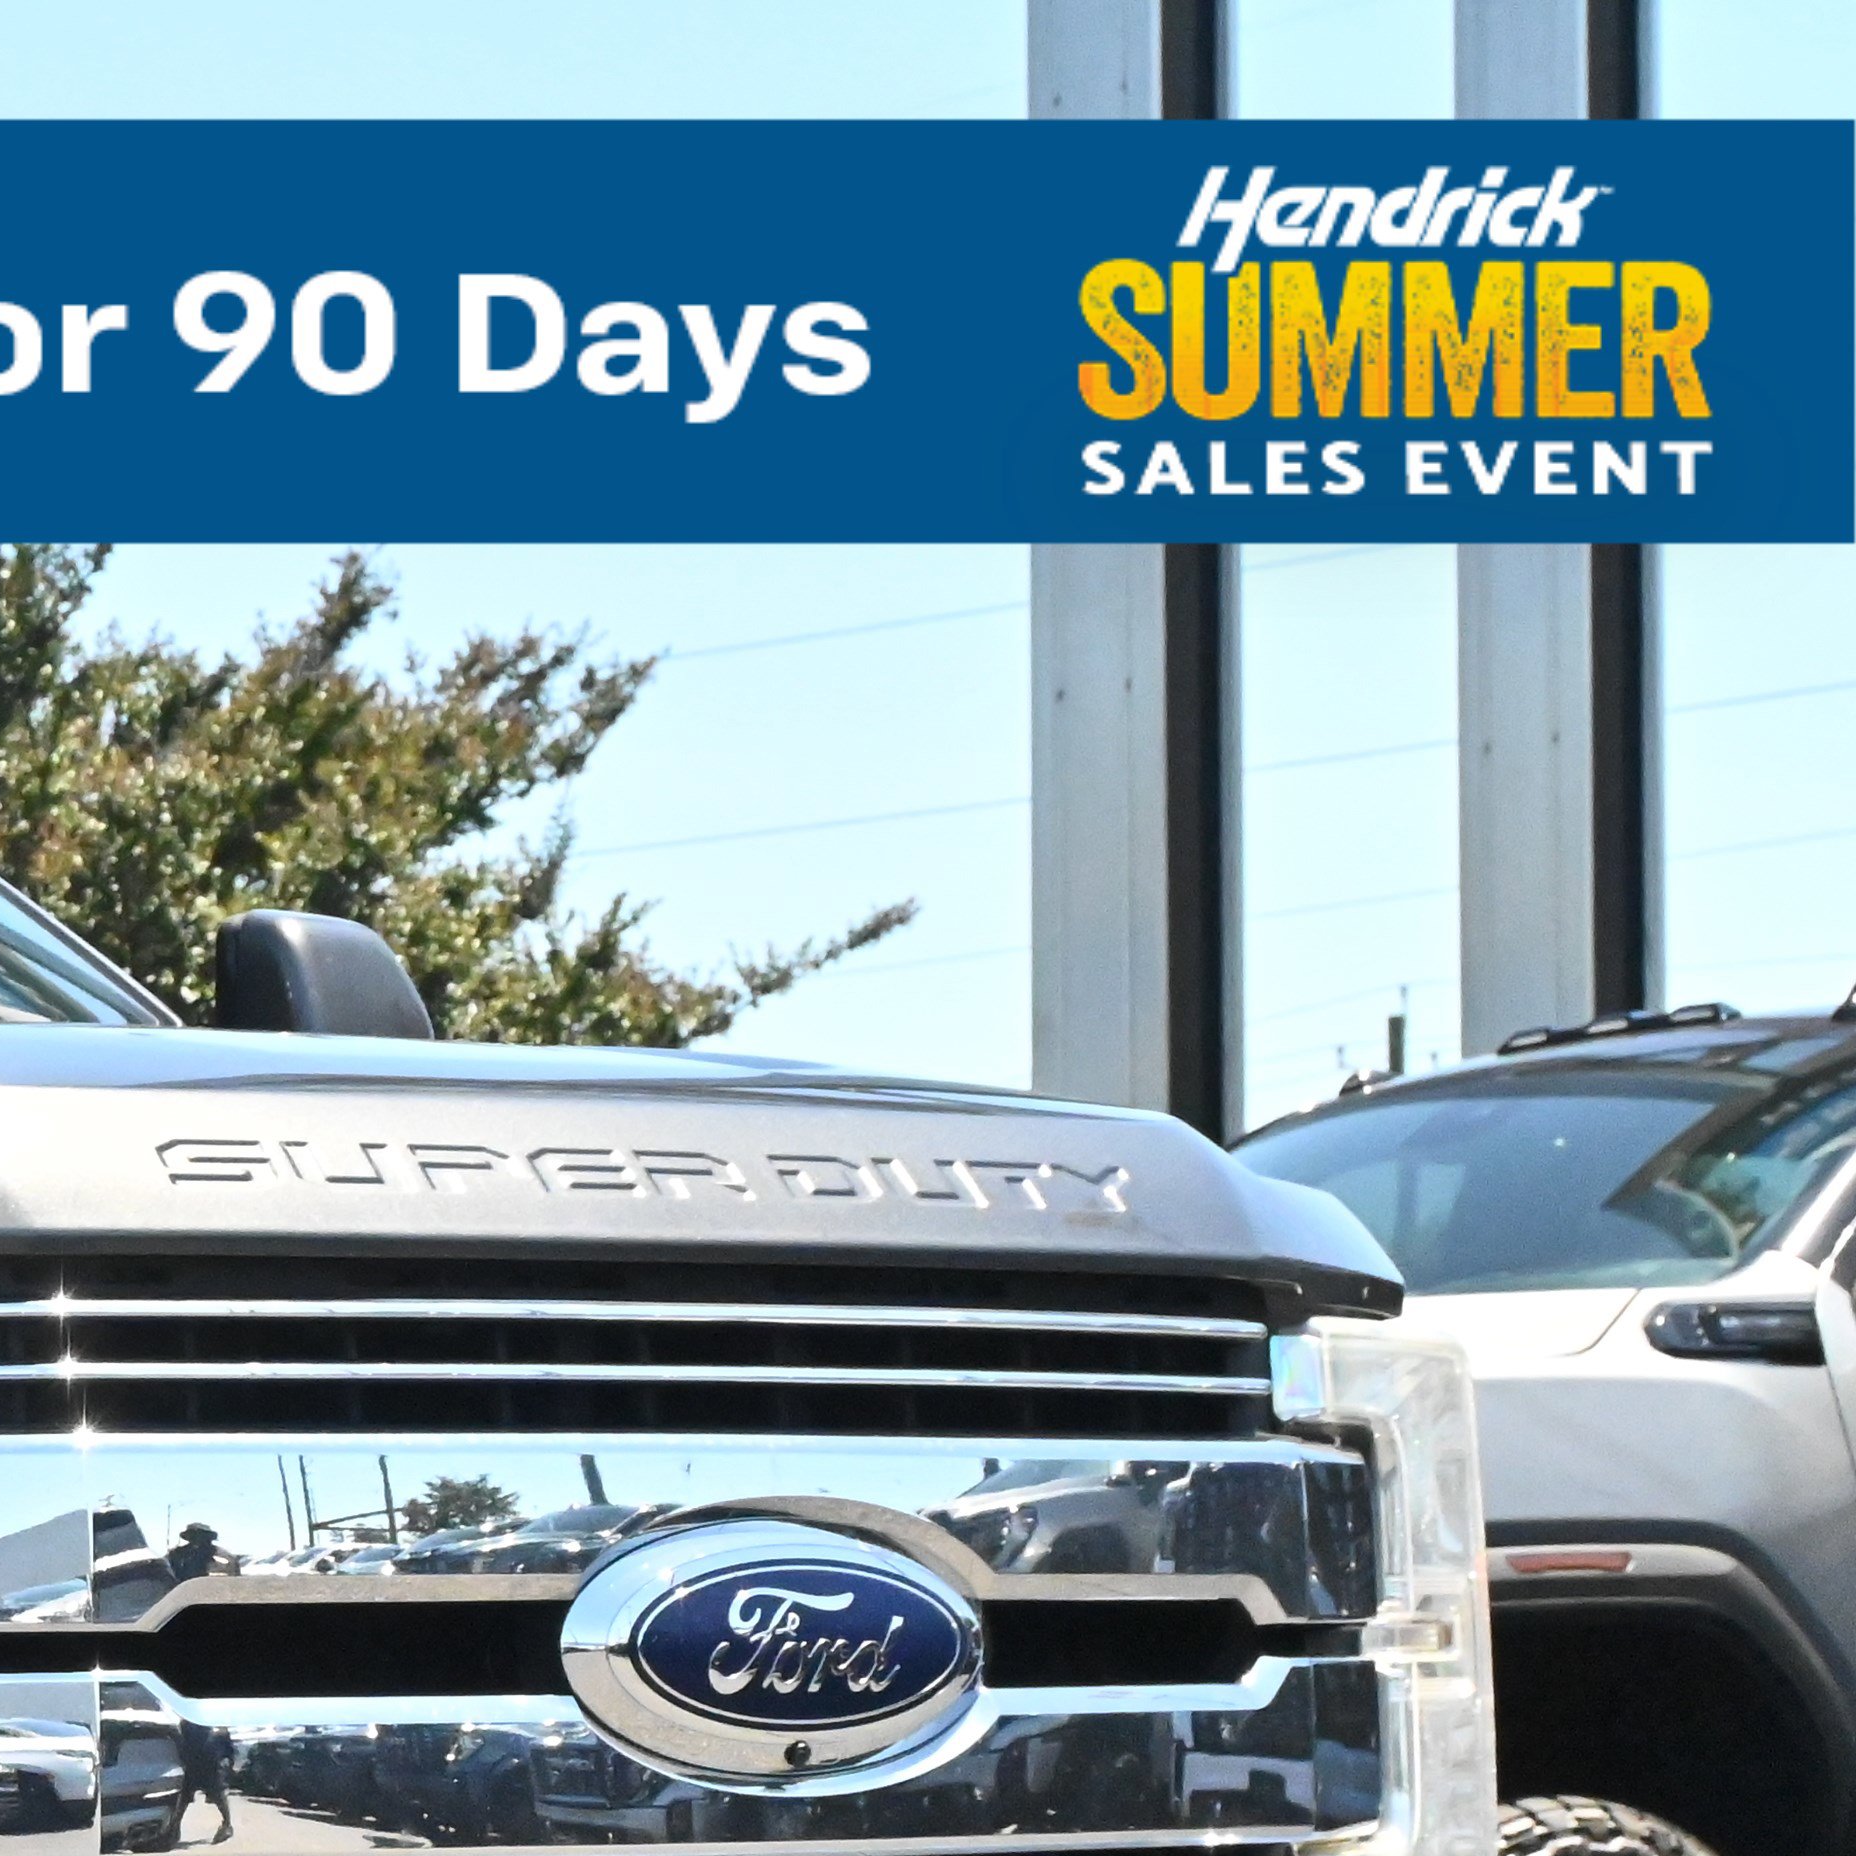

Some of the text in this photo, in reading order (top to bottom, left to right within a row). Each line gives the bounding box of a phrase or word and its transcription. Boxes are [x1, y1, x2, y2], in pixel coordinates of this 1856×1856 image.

[155, 1139, 1134, 1213] SUPER DUTY
[708, 1586, 904, 1695] Ford
